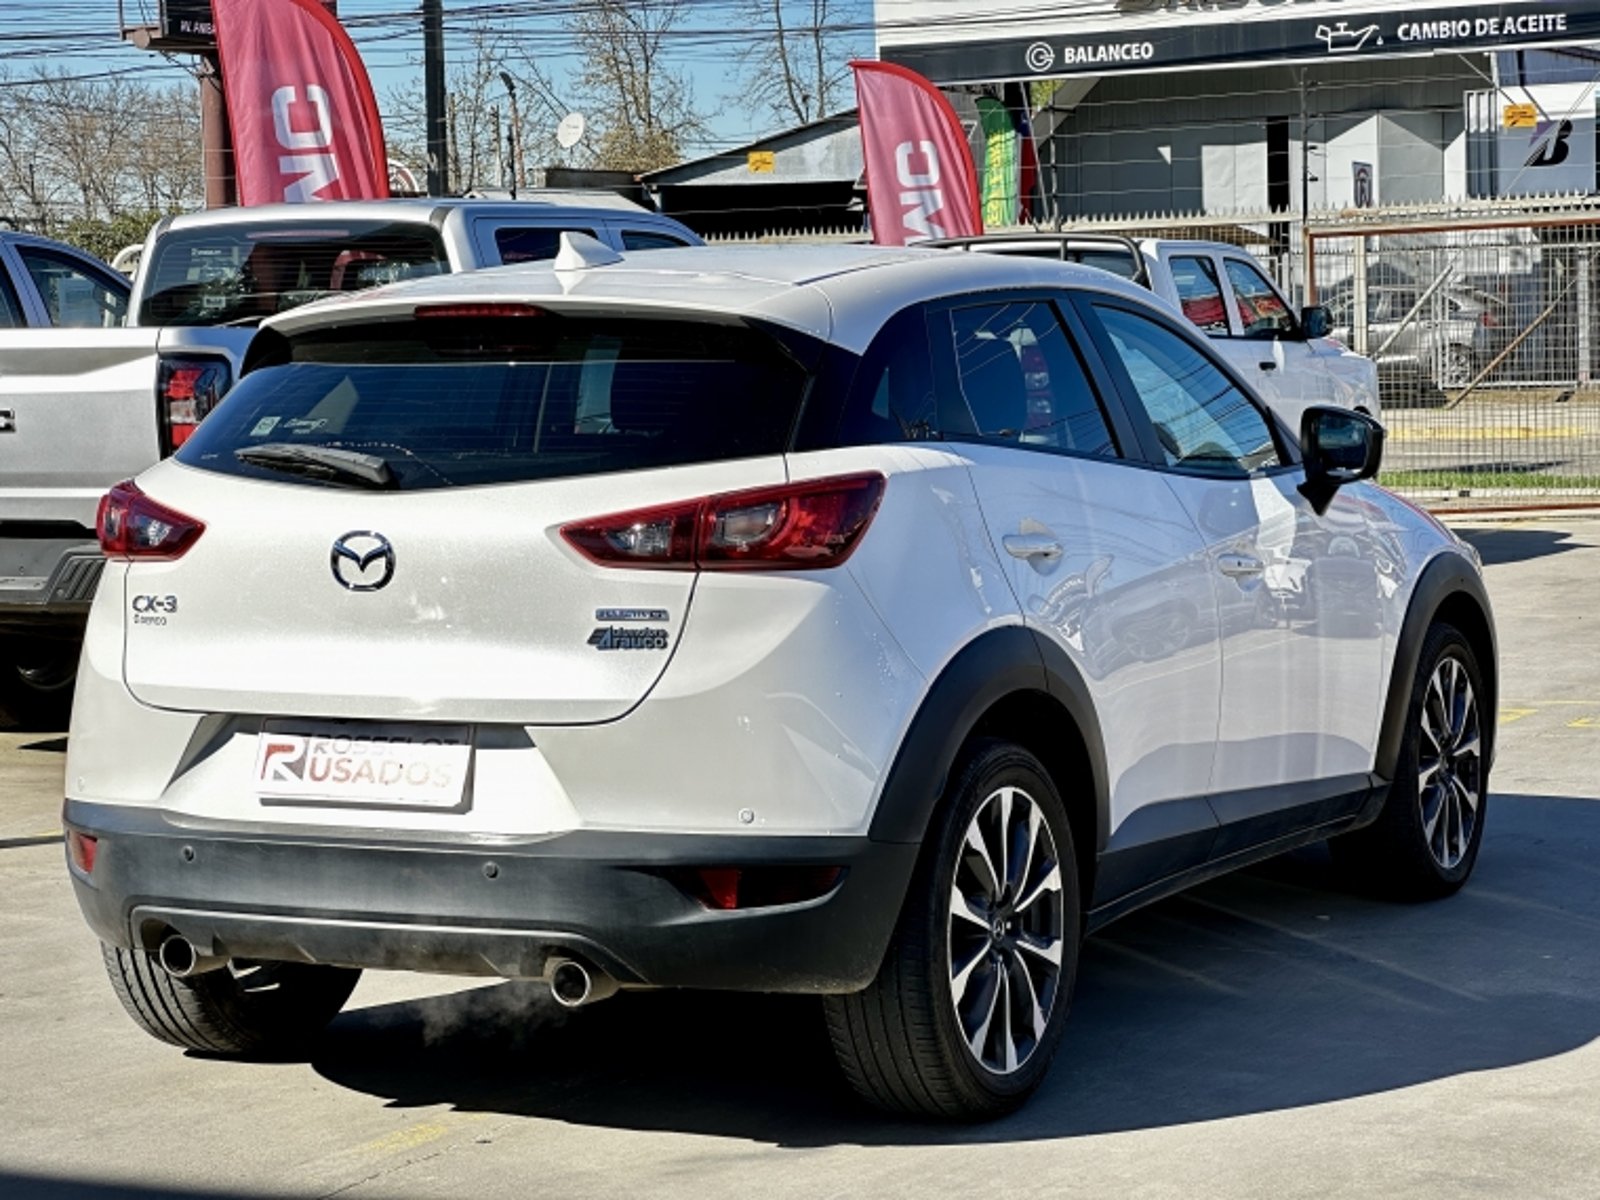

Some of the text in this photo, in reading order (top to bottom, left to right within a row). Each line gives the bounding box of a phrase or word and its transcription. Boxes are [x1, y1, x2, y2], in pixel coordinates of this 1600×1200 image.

[1397, 13, 1568, 41] CAMBIO DE ACEITE
[1063, 41, 1154, 64] BALANCEO
[132, 594, 178, 613] CX-3
[313, 734, 460, 758] ROSS
[309, 756, 453, 788] USADOS
